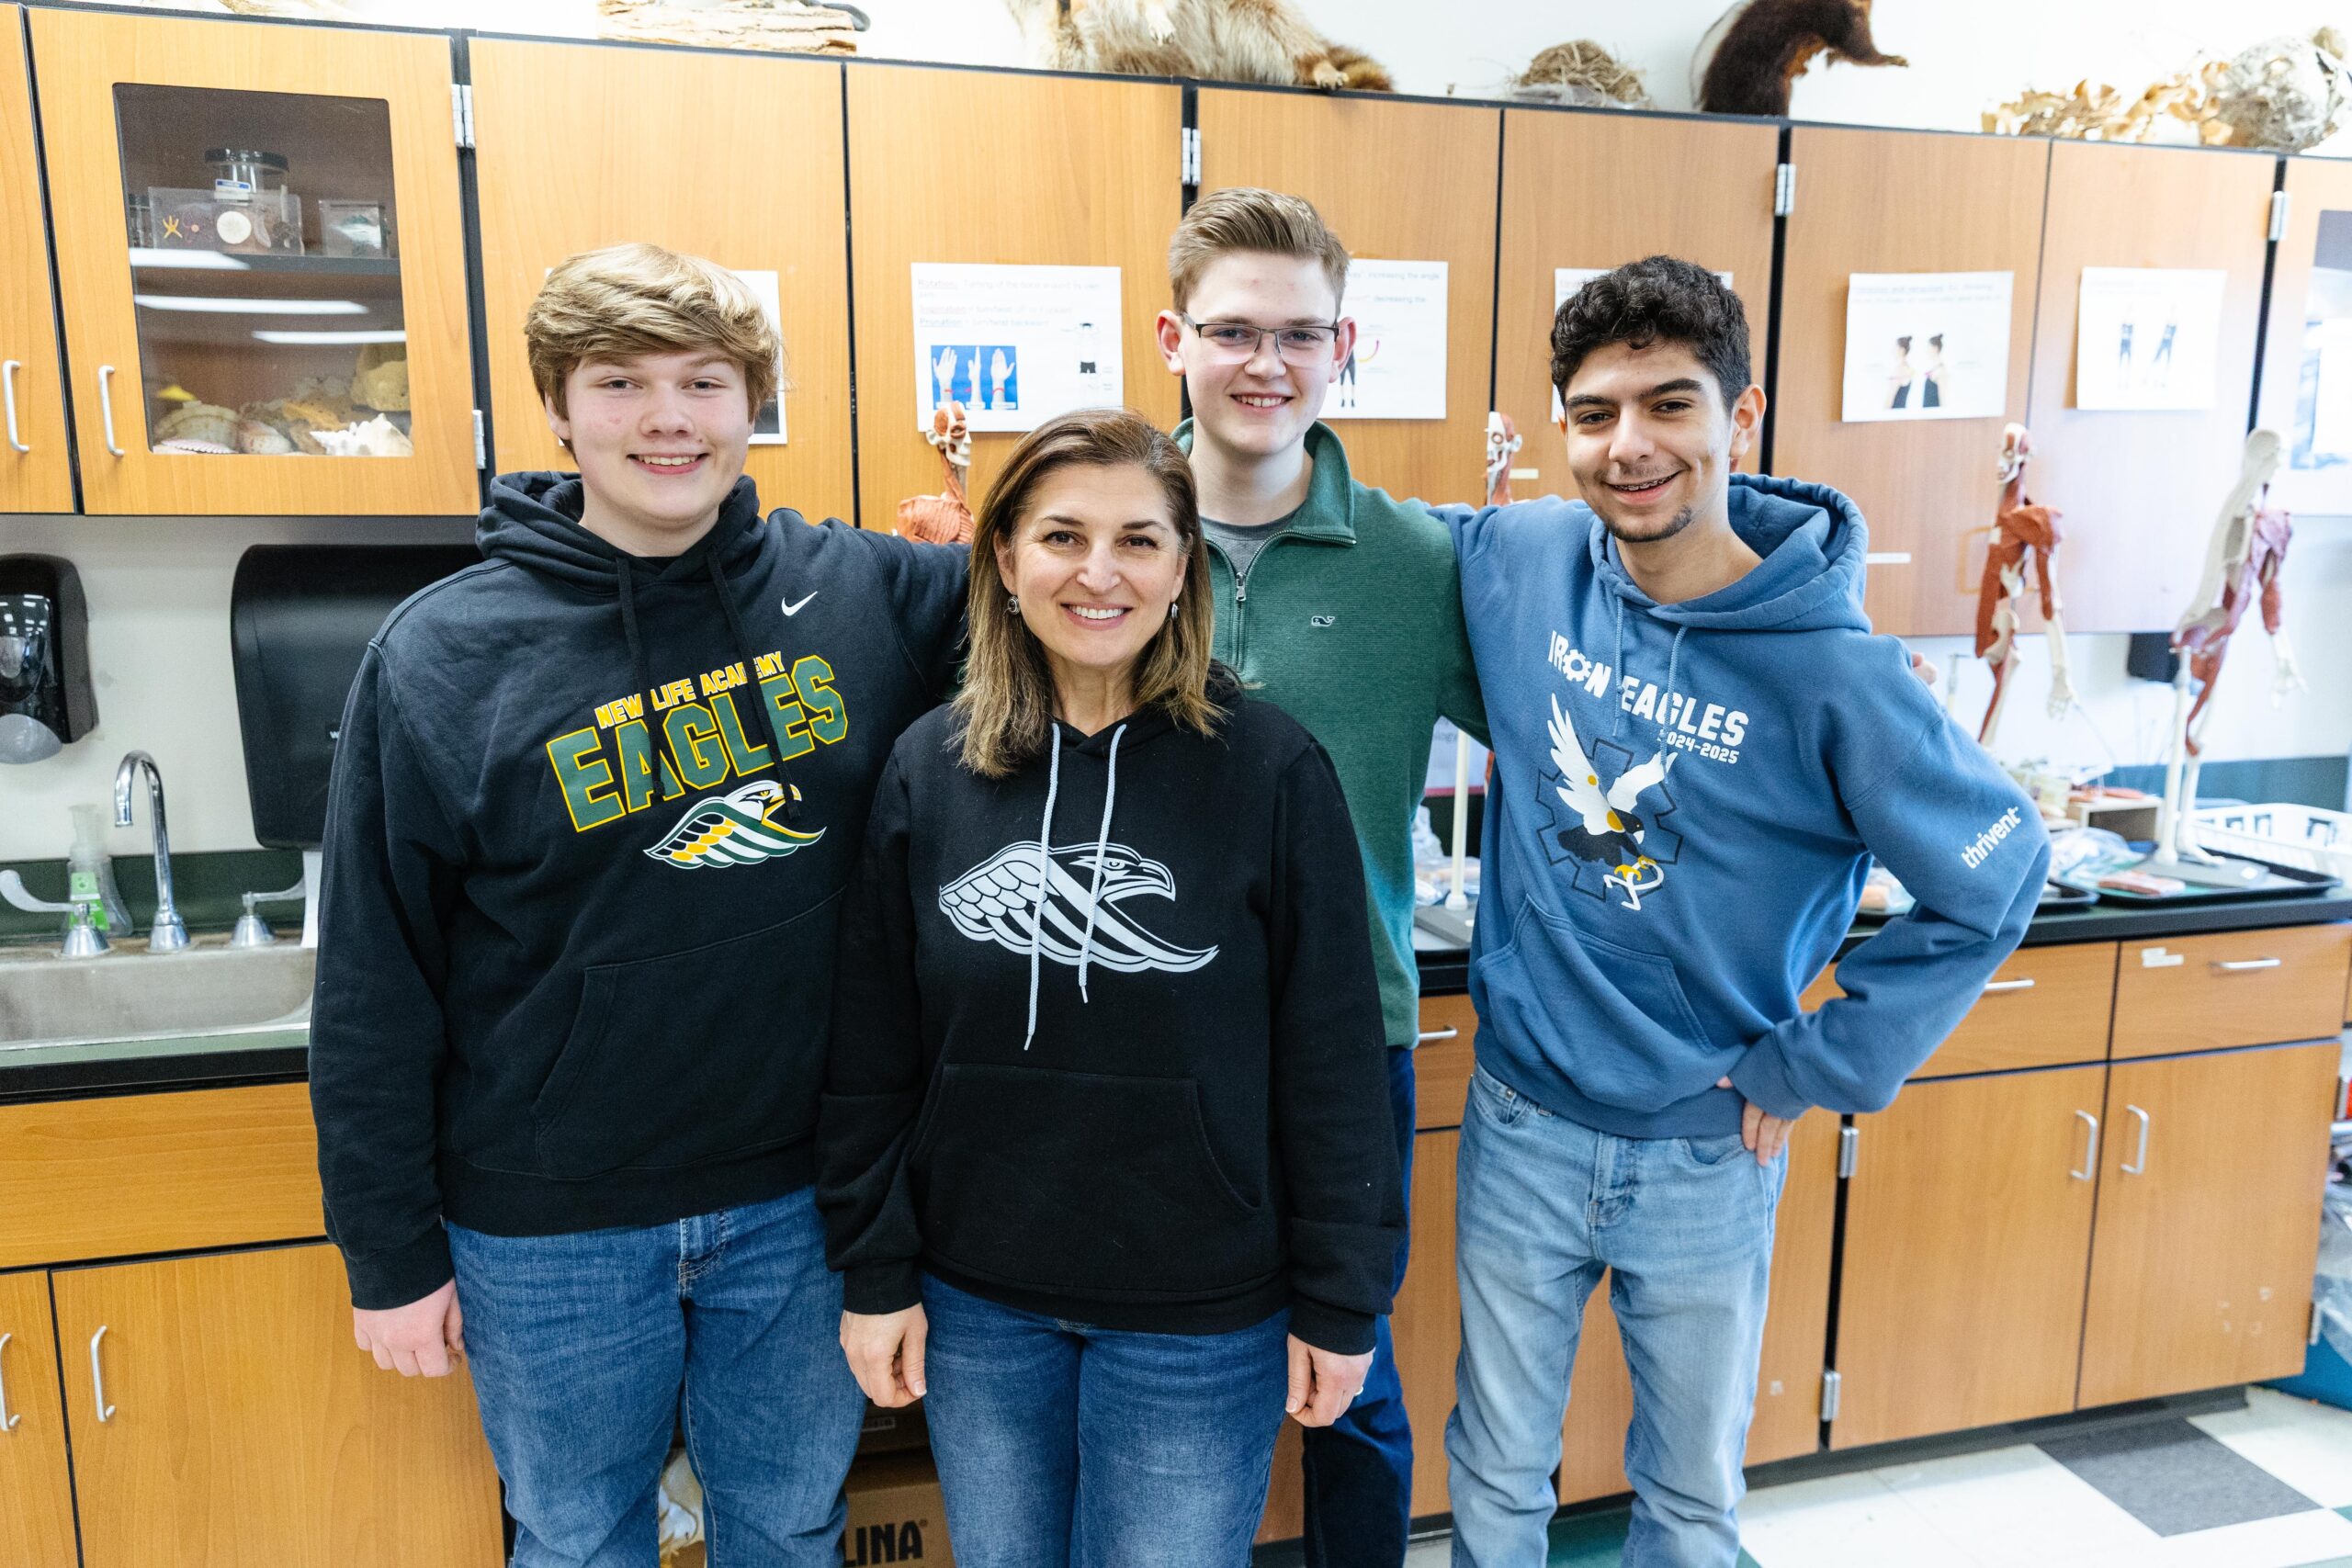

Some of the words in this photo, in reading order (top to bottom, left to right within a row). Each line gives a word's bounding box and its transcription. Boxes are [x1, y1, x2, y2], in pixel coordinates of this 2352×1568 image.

[594, 693, 644, 729] NEW
[650, 678, 696, 711] LIFE
[1548, 630, 1611, 698] IRON
[1621, 675, 1749, 747] EAGLES
[546, 654, 848, 832] EAGLES
[1657, 729, 1740, 765] 024-2025
[1961, 807, 2022, 869] thrivent
